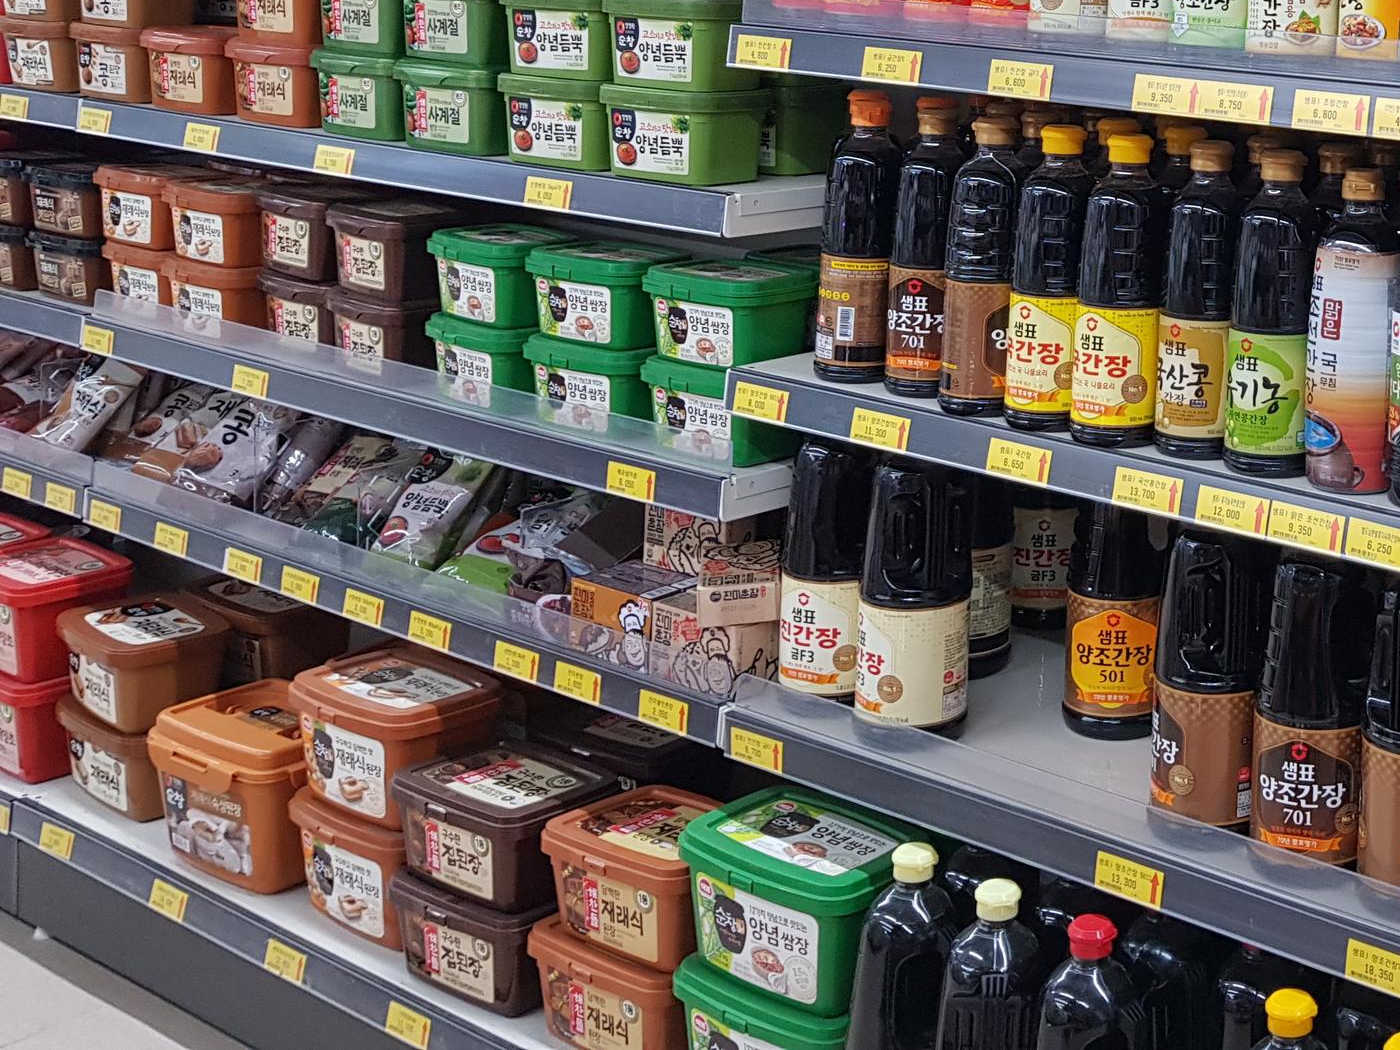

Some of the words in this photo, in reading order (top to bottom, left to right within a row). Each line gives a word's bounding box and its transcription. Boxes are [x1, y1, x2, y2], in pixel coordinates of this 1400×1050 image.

[878, 63, 896, 74] 6,250
[1150, 92, 1173, 103] 9,350
[1219, 99, 1242, 110] 8,750
[1312, 108, 1337, 120] 6,800
[900, 334, 925, 350] 701
[1235, 355, 1259, 372] 샘표
[791, 605, 817, 625] 샘표
[779, 619, 842, 648] 진간장
[1097, 628, 1128, 646] 샘표
[790, 646, 815, 664] 금F3
[1076, 643, 1152, 669] 양조간장
[1099, 668, 1126, 684] 501
[1282, 761, 1315, 783] 샘표
[1259, 773, 1346, 808] 양조간장
[1283, 808, 1313, 826] 701
[601, 901, 644, 937] 재래식
